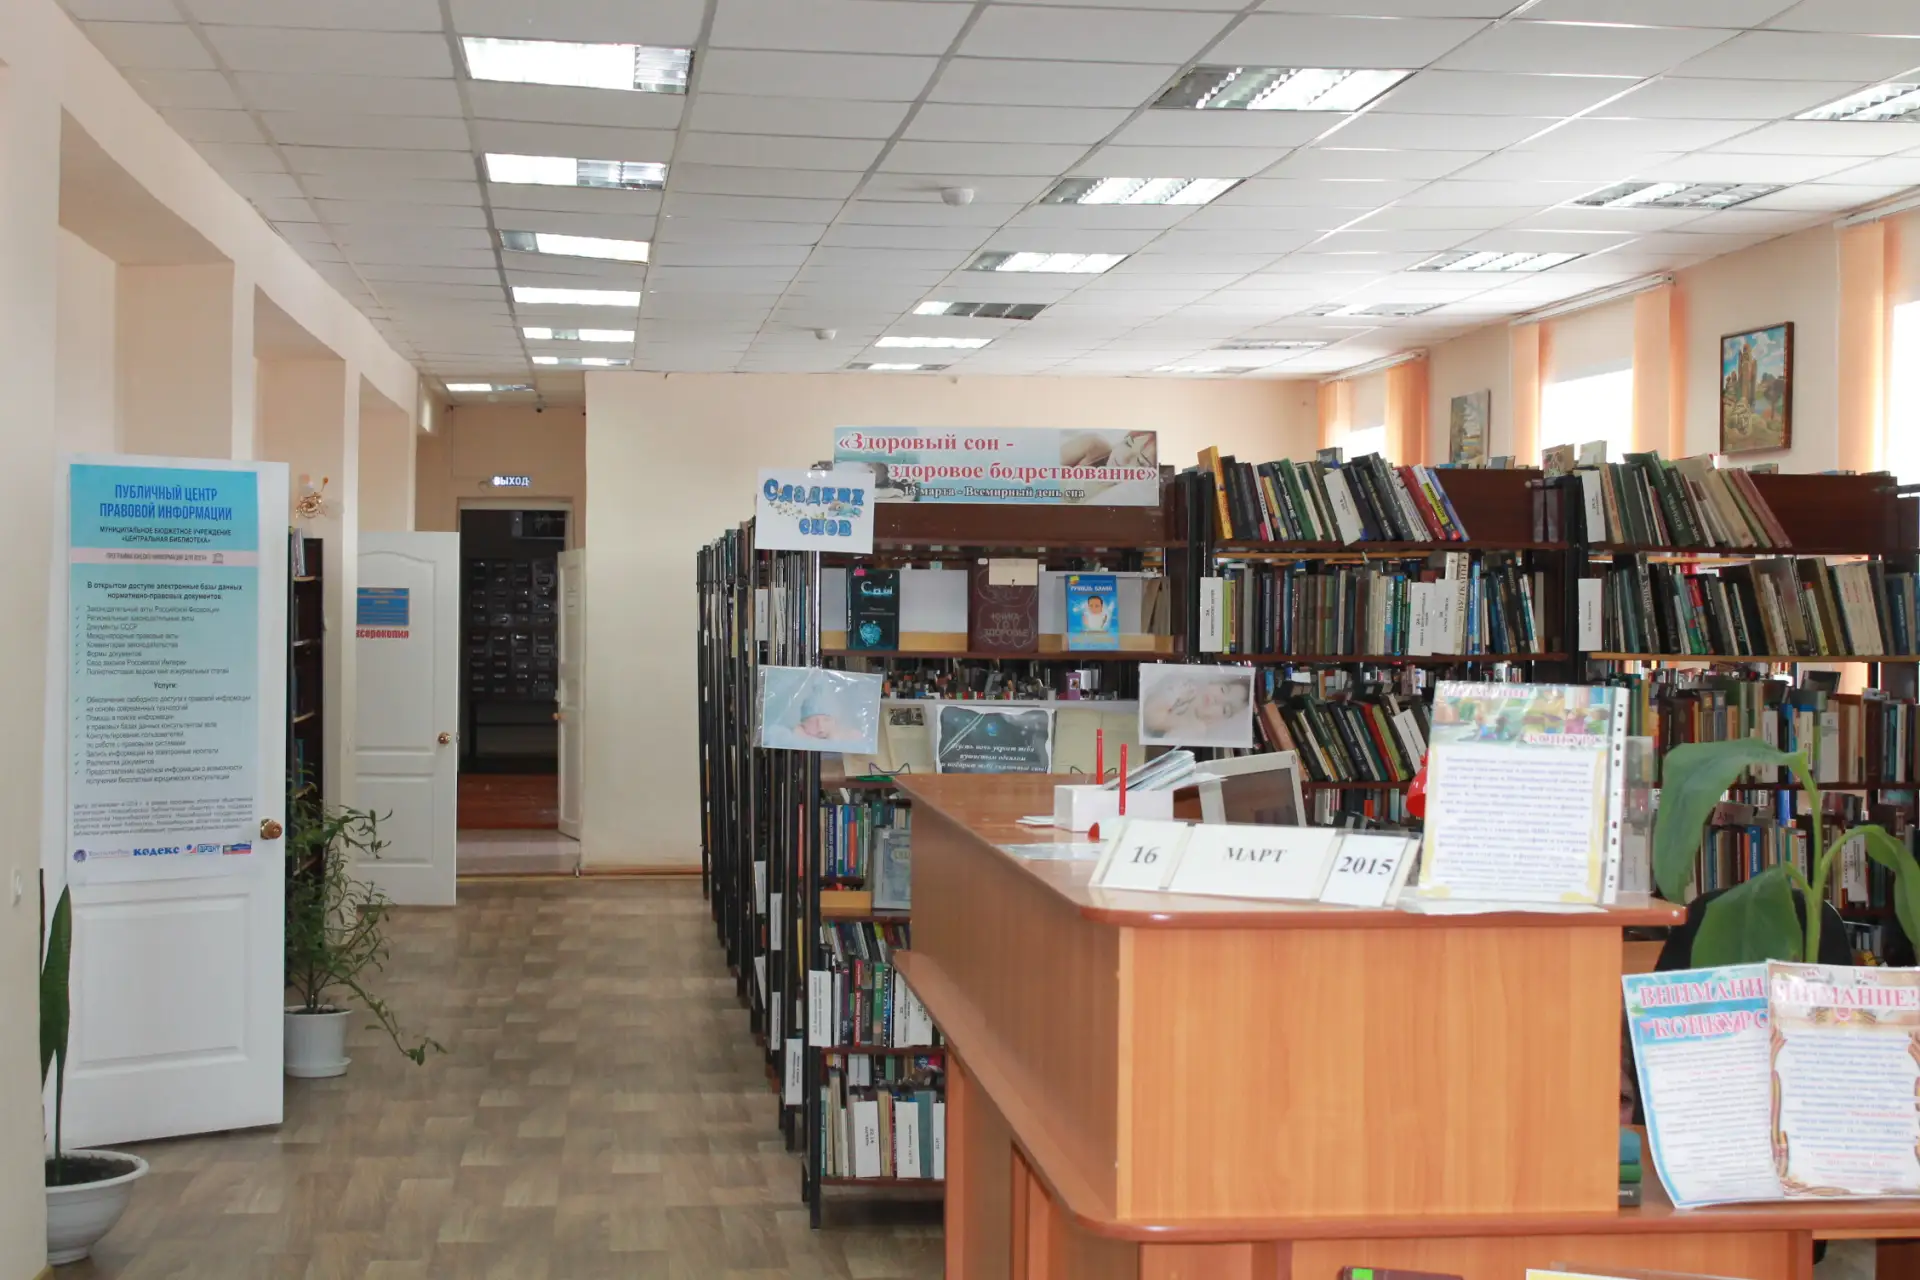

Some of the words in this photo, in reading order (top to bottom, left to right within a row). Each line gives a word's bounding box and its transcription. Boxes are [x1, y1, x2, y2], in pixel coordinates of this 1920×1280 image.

[839, 431, 956, 454] «Здоровый
[964, 438, 999, 451] сон
[493, 476, 529, 486] ВЫХОД
[889, 465, 984, 481] здоровое
[989, 462, 1157, 482] бодрствование»
[115, 484, 182, 500] ПУБЛИЧНЫЙ
[185, 487, 218, 502] ЦЕНТР
[764, 478, 864, 507] Сладких
[920, 487, 955, 498] марта
[965, 486, 1032, 500] Всемирный
[1034, 488, 1062, 500] день
[1065, 489, 1084, 498] сна
[100, 502, 156, 518] ПРАВОВОЙ
[158, 506, 232, 521] ИНФОРМАЦИИ
[100, 526, 154, 534] МУНИЦИПАЛЬНОЕ
[200, 582, 217, 590] базы
[1132, 846, 1160, 864] 16
[1225, 846, 1288, 863] МАРТ
[1338, 856, 1394, 876] 2015
[1640, 978, 1768, 1008] ВНИМАНИ
